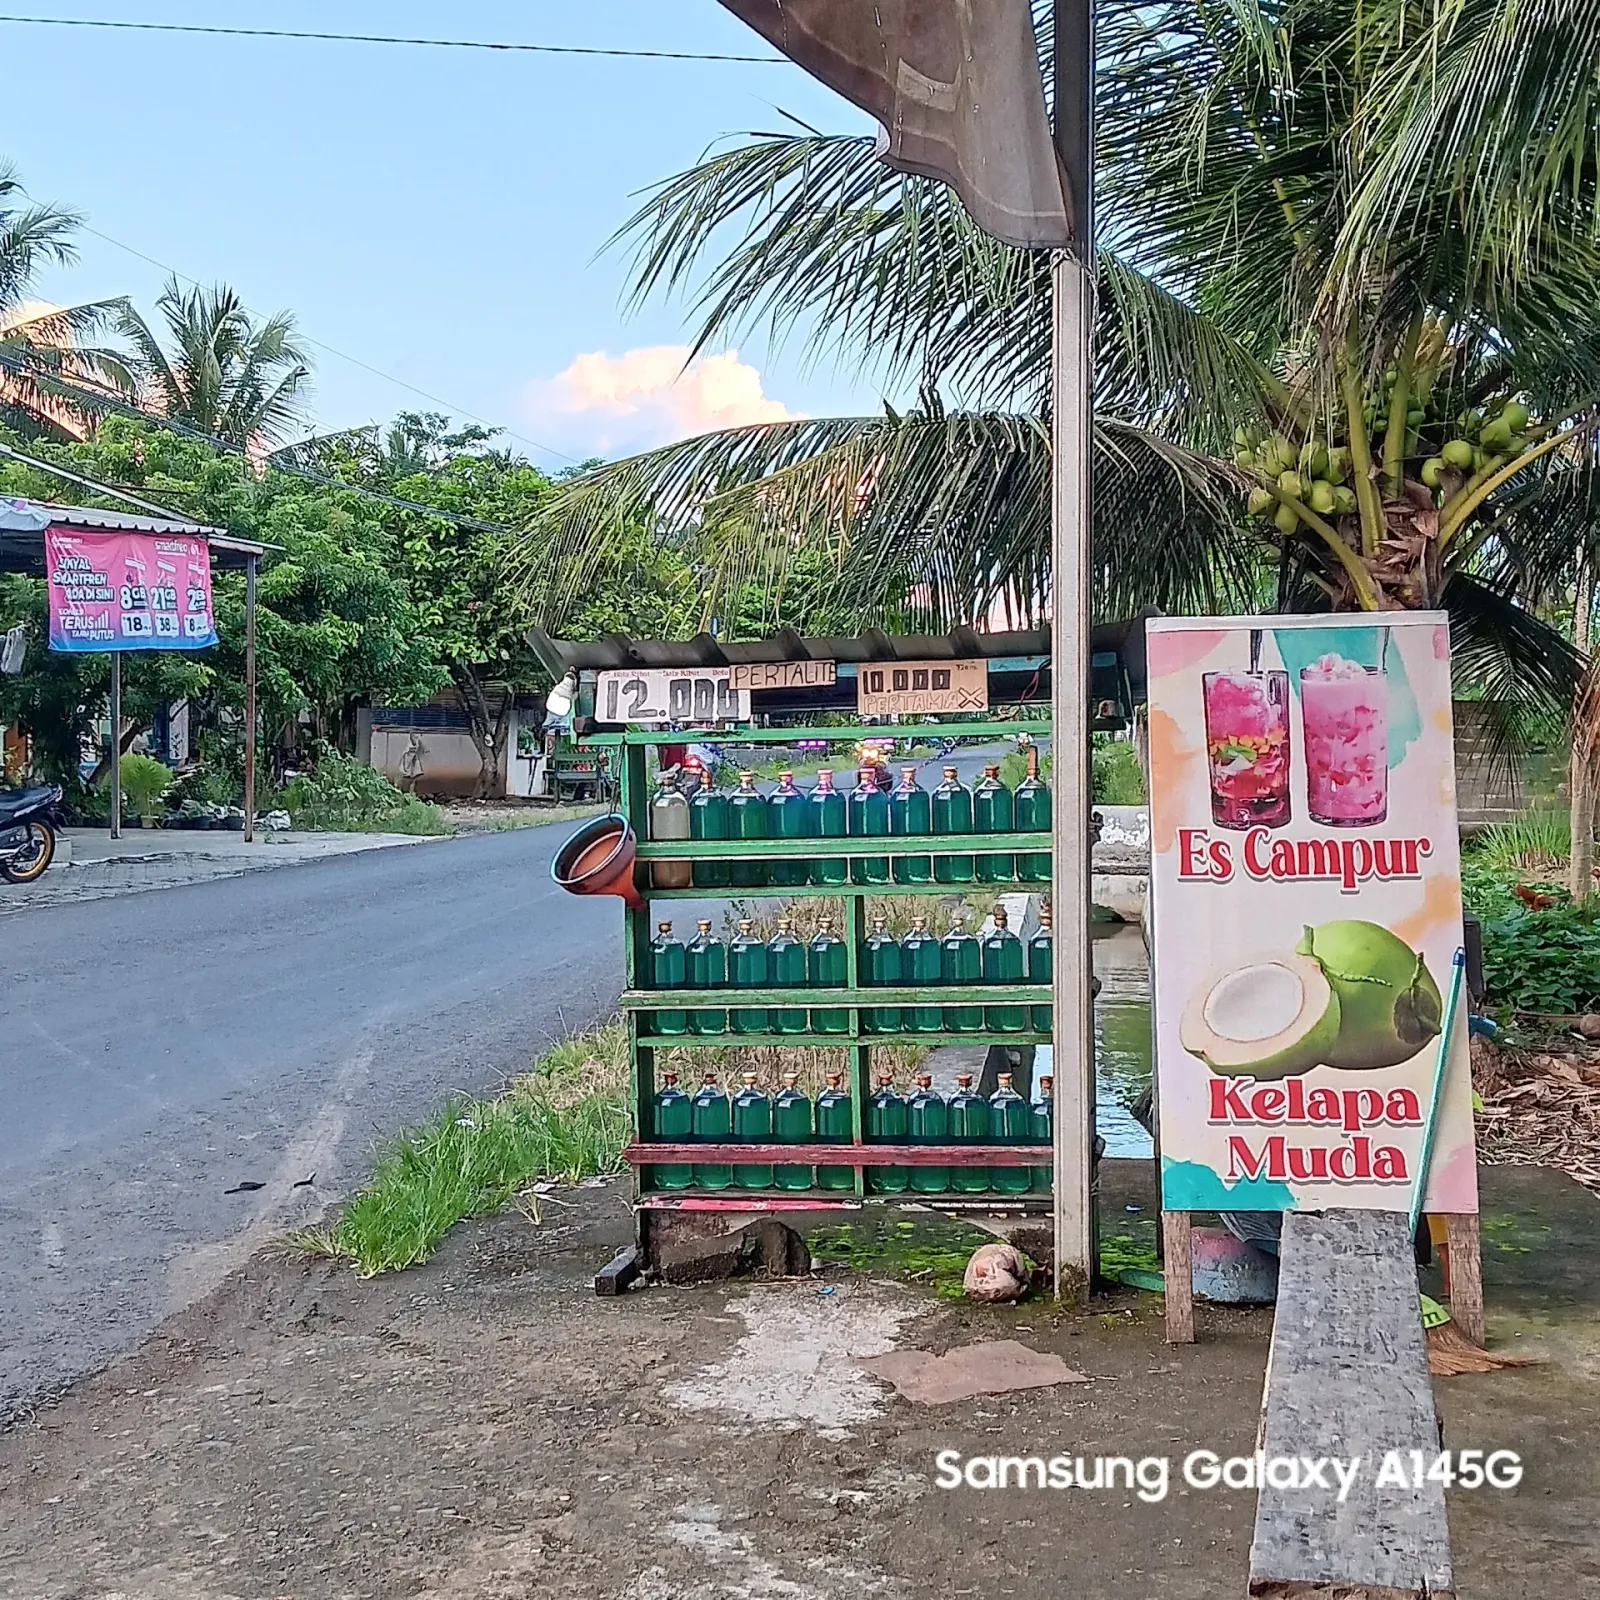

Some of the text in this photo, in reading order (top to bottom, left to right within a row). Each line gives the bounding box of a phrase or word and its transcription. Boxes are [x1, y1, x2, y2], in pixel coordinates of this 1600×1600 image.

[96, 588, 114, 600] SINI
[60, 615, 95, 630] TERUS
[90, 629, 115, 640] PUTUS
[733, 661, 836, 688] PERTALITE
[863, 669, 951, 695] 10.000
[606, 678, 740, 720] 12.000
[863, 687, 985, 714] PERTAMAX
[1178, 827, 1431, 889] Es Campur
[1209, 1078, 1422, 1132] Kelapa
[1226, 1136, 1409, 1179] Muda
